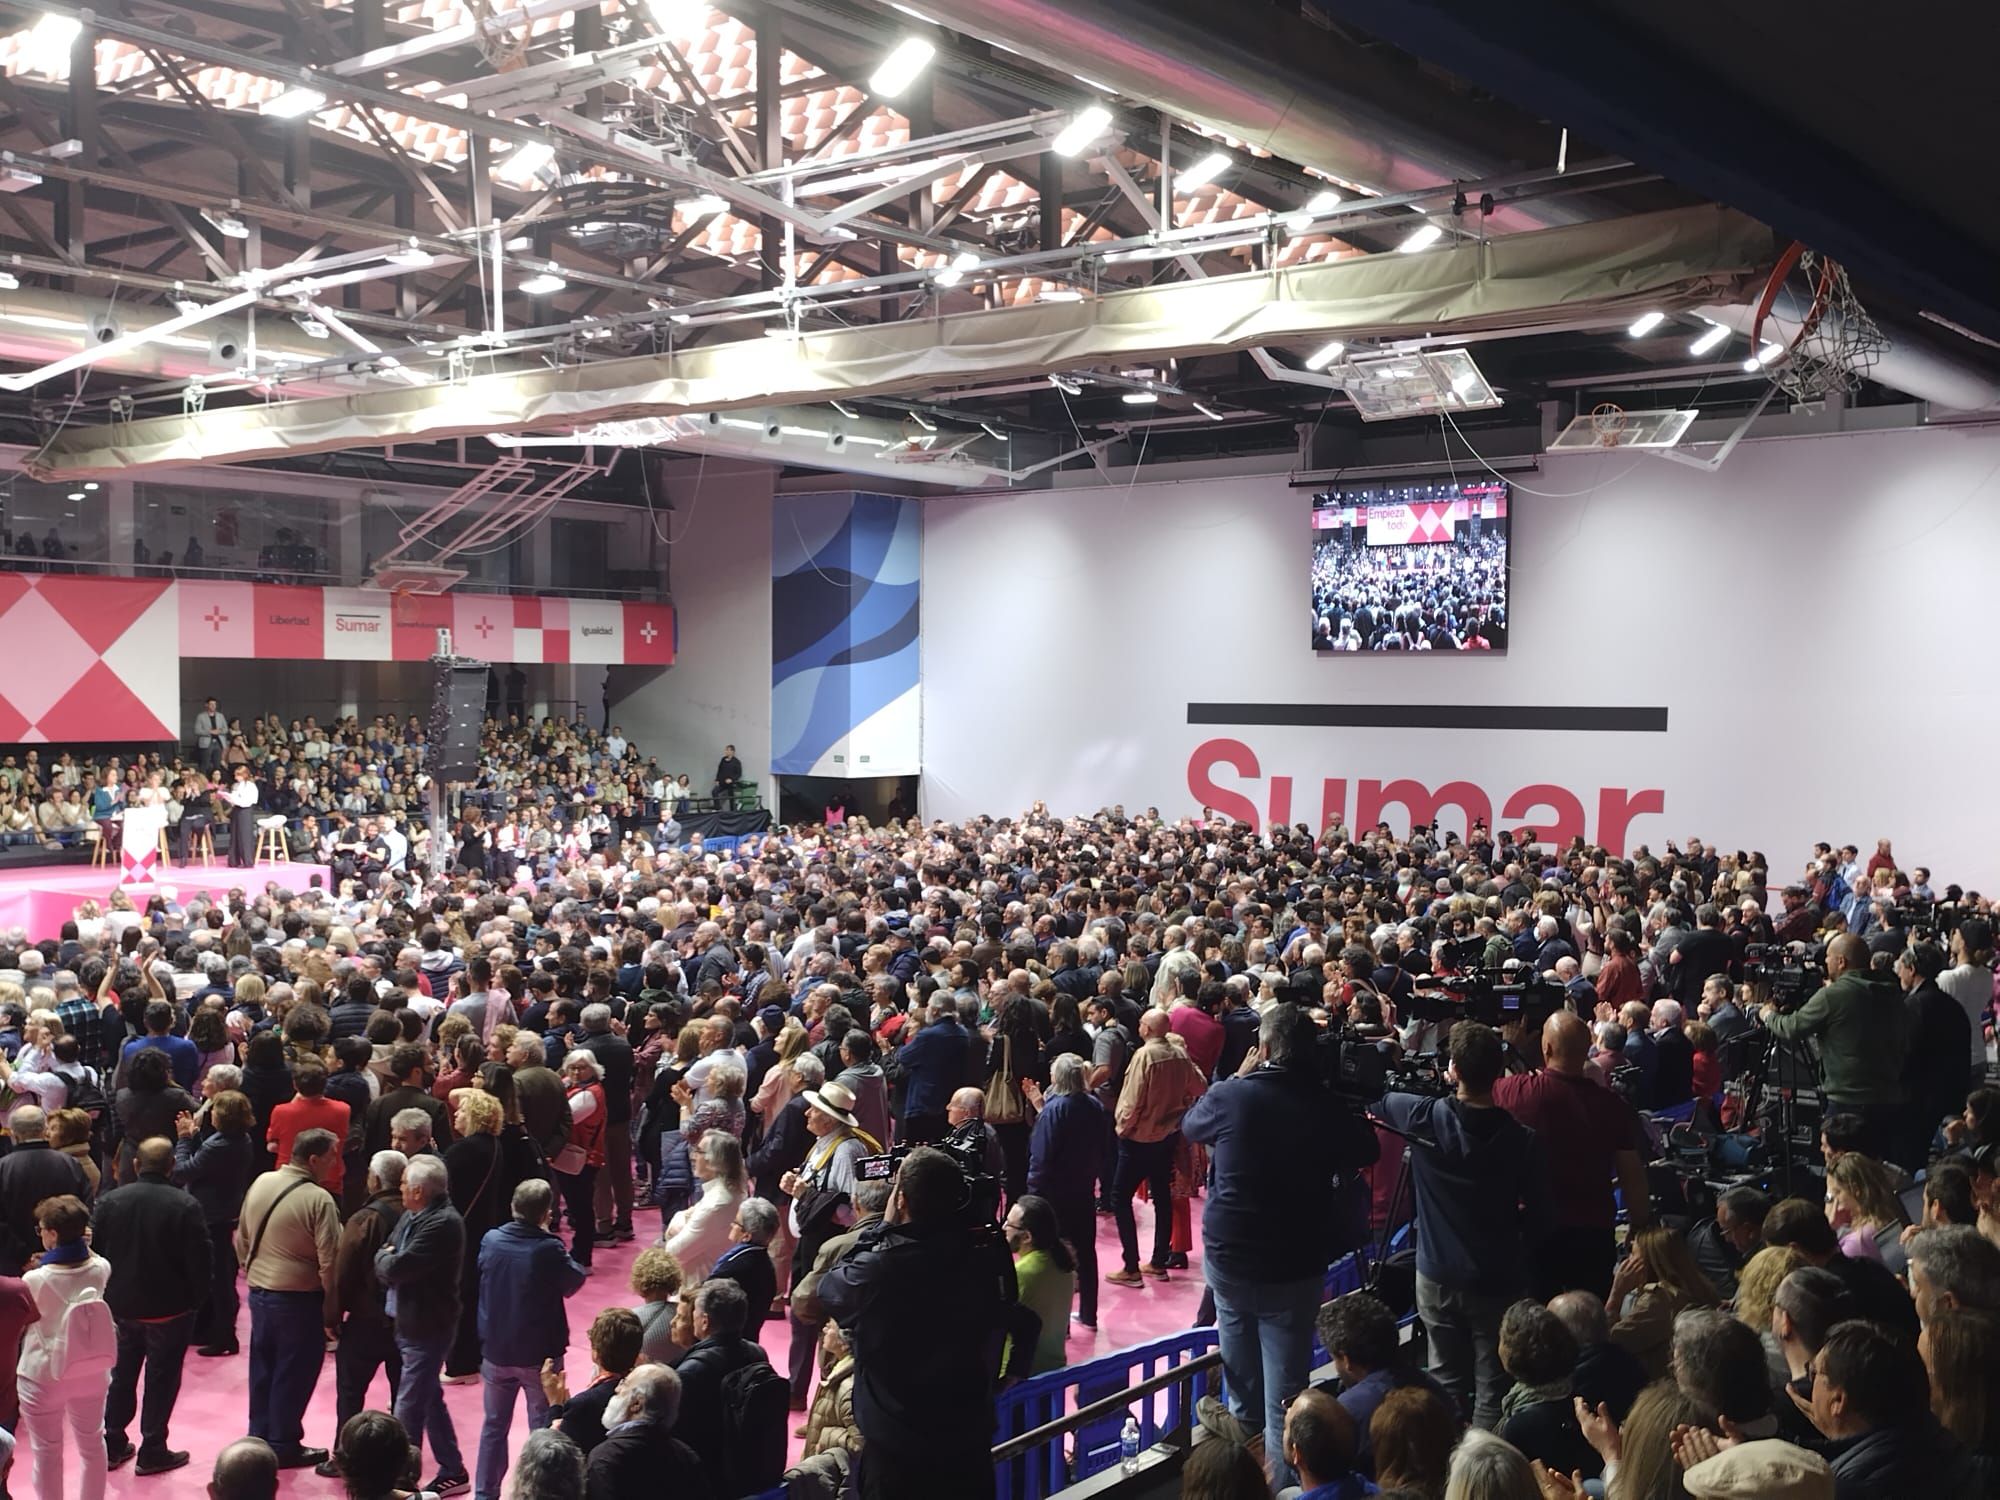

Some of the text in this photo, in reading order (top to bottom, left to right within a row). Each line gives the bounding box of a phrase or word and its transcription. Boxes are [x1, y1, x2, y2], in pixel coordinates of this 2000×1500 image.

[1368, 508, 1405, 520] Empieza
[1387, 521, 1408, 530] todo
[269, 615, 310, 625] Libertad
[336, 618, 381, 632] Sumar
[581, 625, 614, 637] Igualdad
[1187, 738, 1665, 858] Sumar
